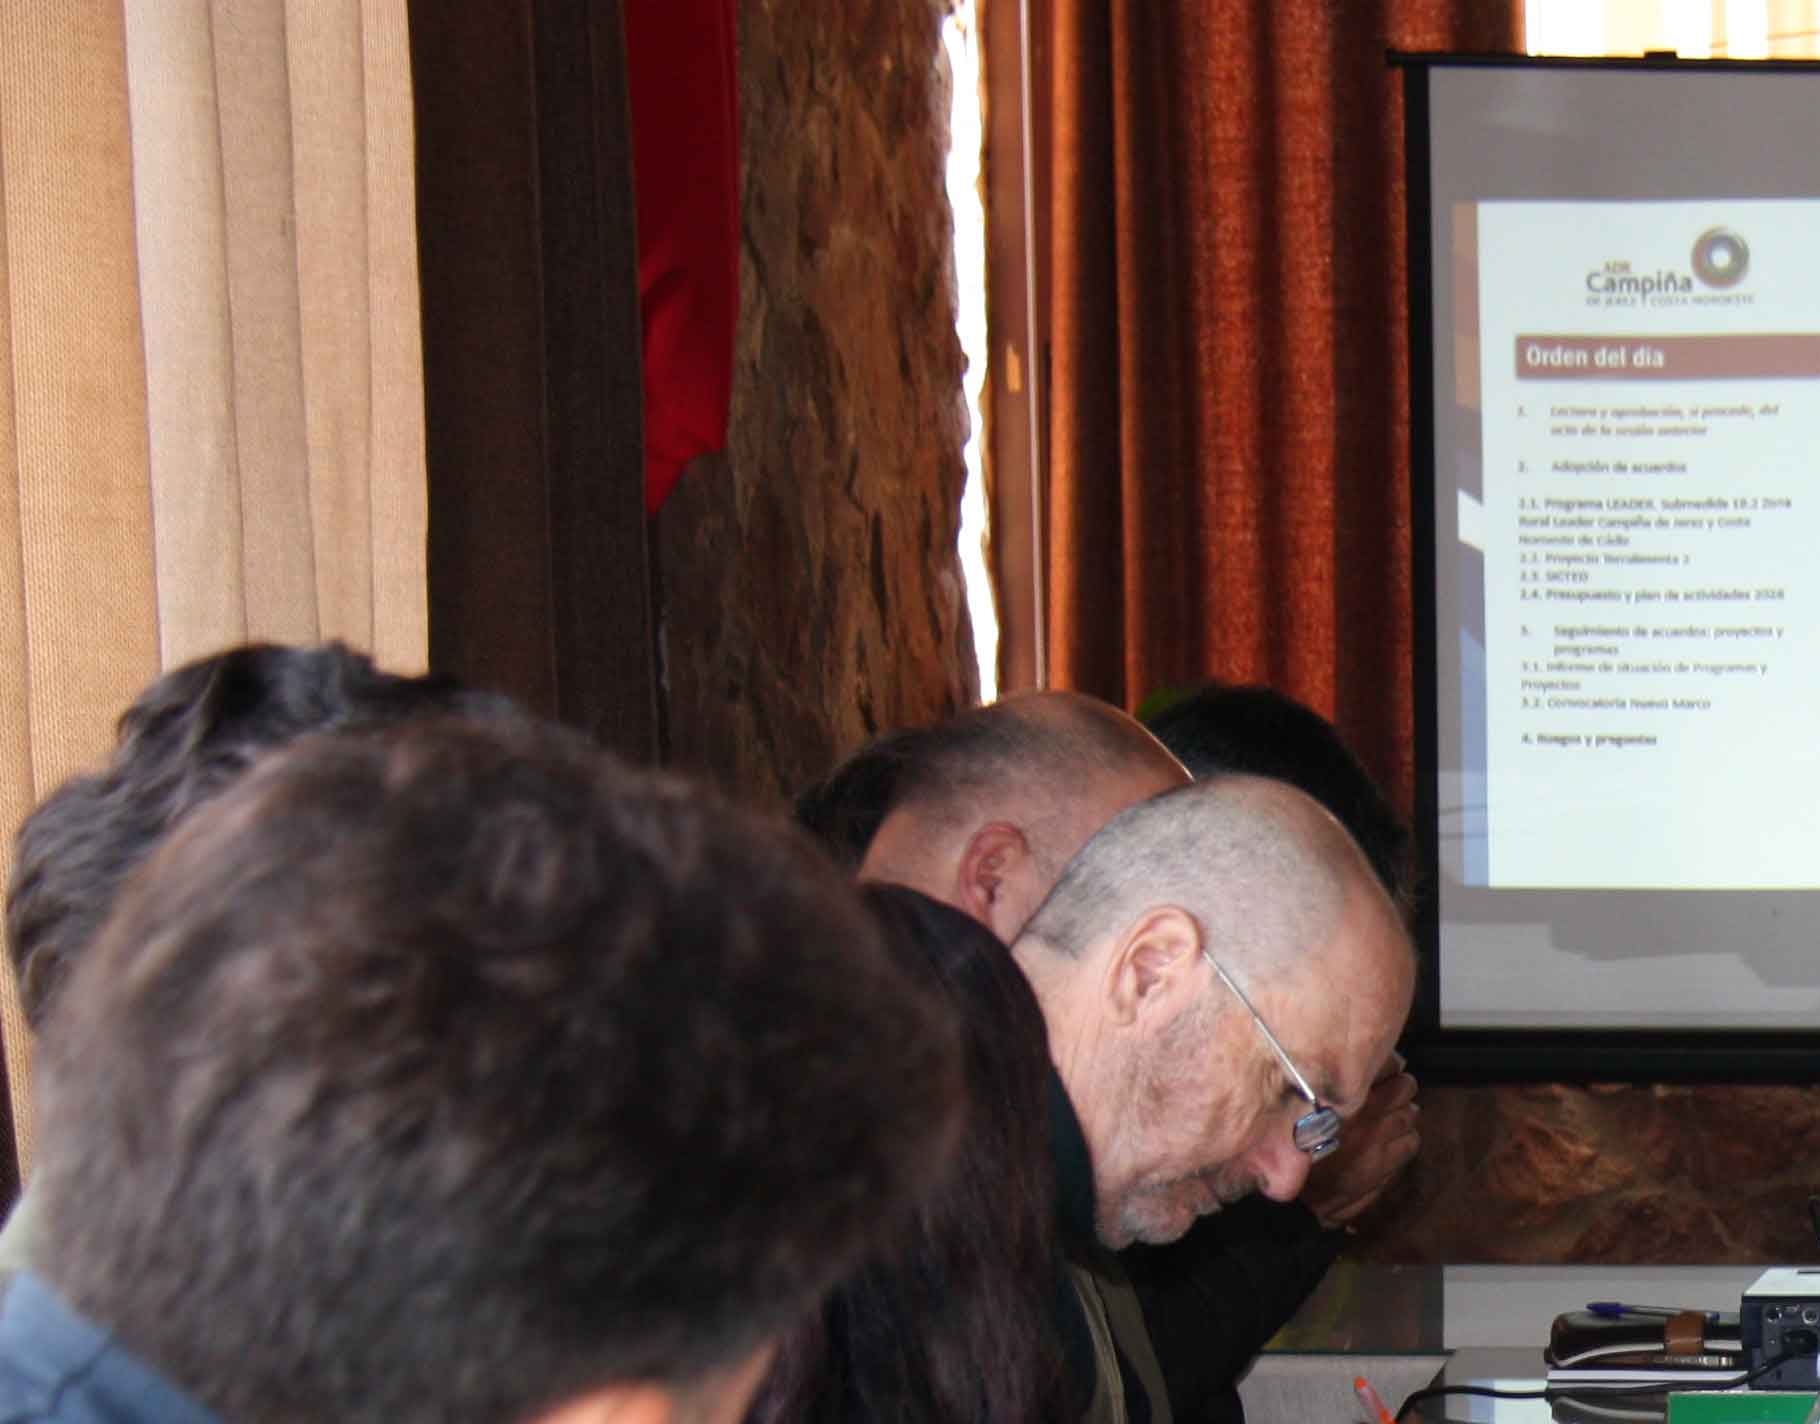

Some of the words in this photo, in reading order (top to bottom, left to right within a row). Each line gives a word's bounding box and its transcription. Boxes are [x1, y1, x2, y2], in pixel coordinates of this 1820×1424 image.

[1586, 269, 1693, 298] Campiña
[1527, 345, 1588, 367] Orden
[1594, 345, 1626, 367] del
[1551, 461, 1609, 475] Adopción
[1613, 461, 1628, 473] de
[1554, 625, 1630, 640] Seguimiento
[1632, 625, 1648, 637] de
[1547, 662, 1595, 673] Informe
[1598, 662, 1613, 673] de
[1675, 662, 1690, 673] de
[1521, 679, 1581, 693] Proyectos
[1547, 698, 1626, 710] Convocatoria
[1672, 698, 1711, 709] Marco
